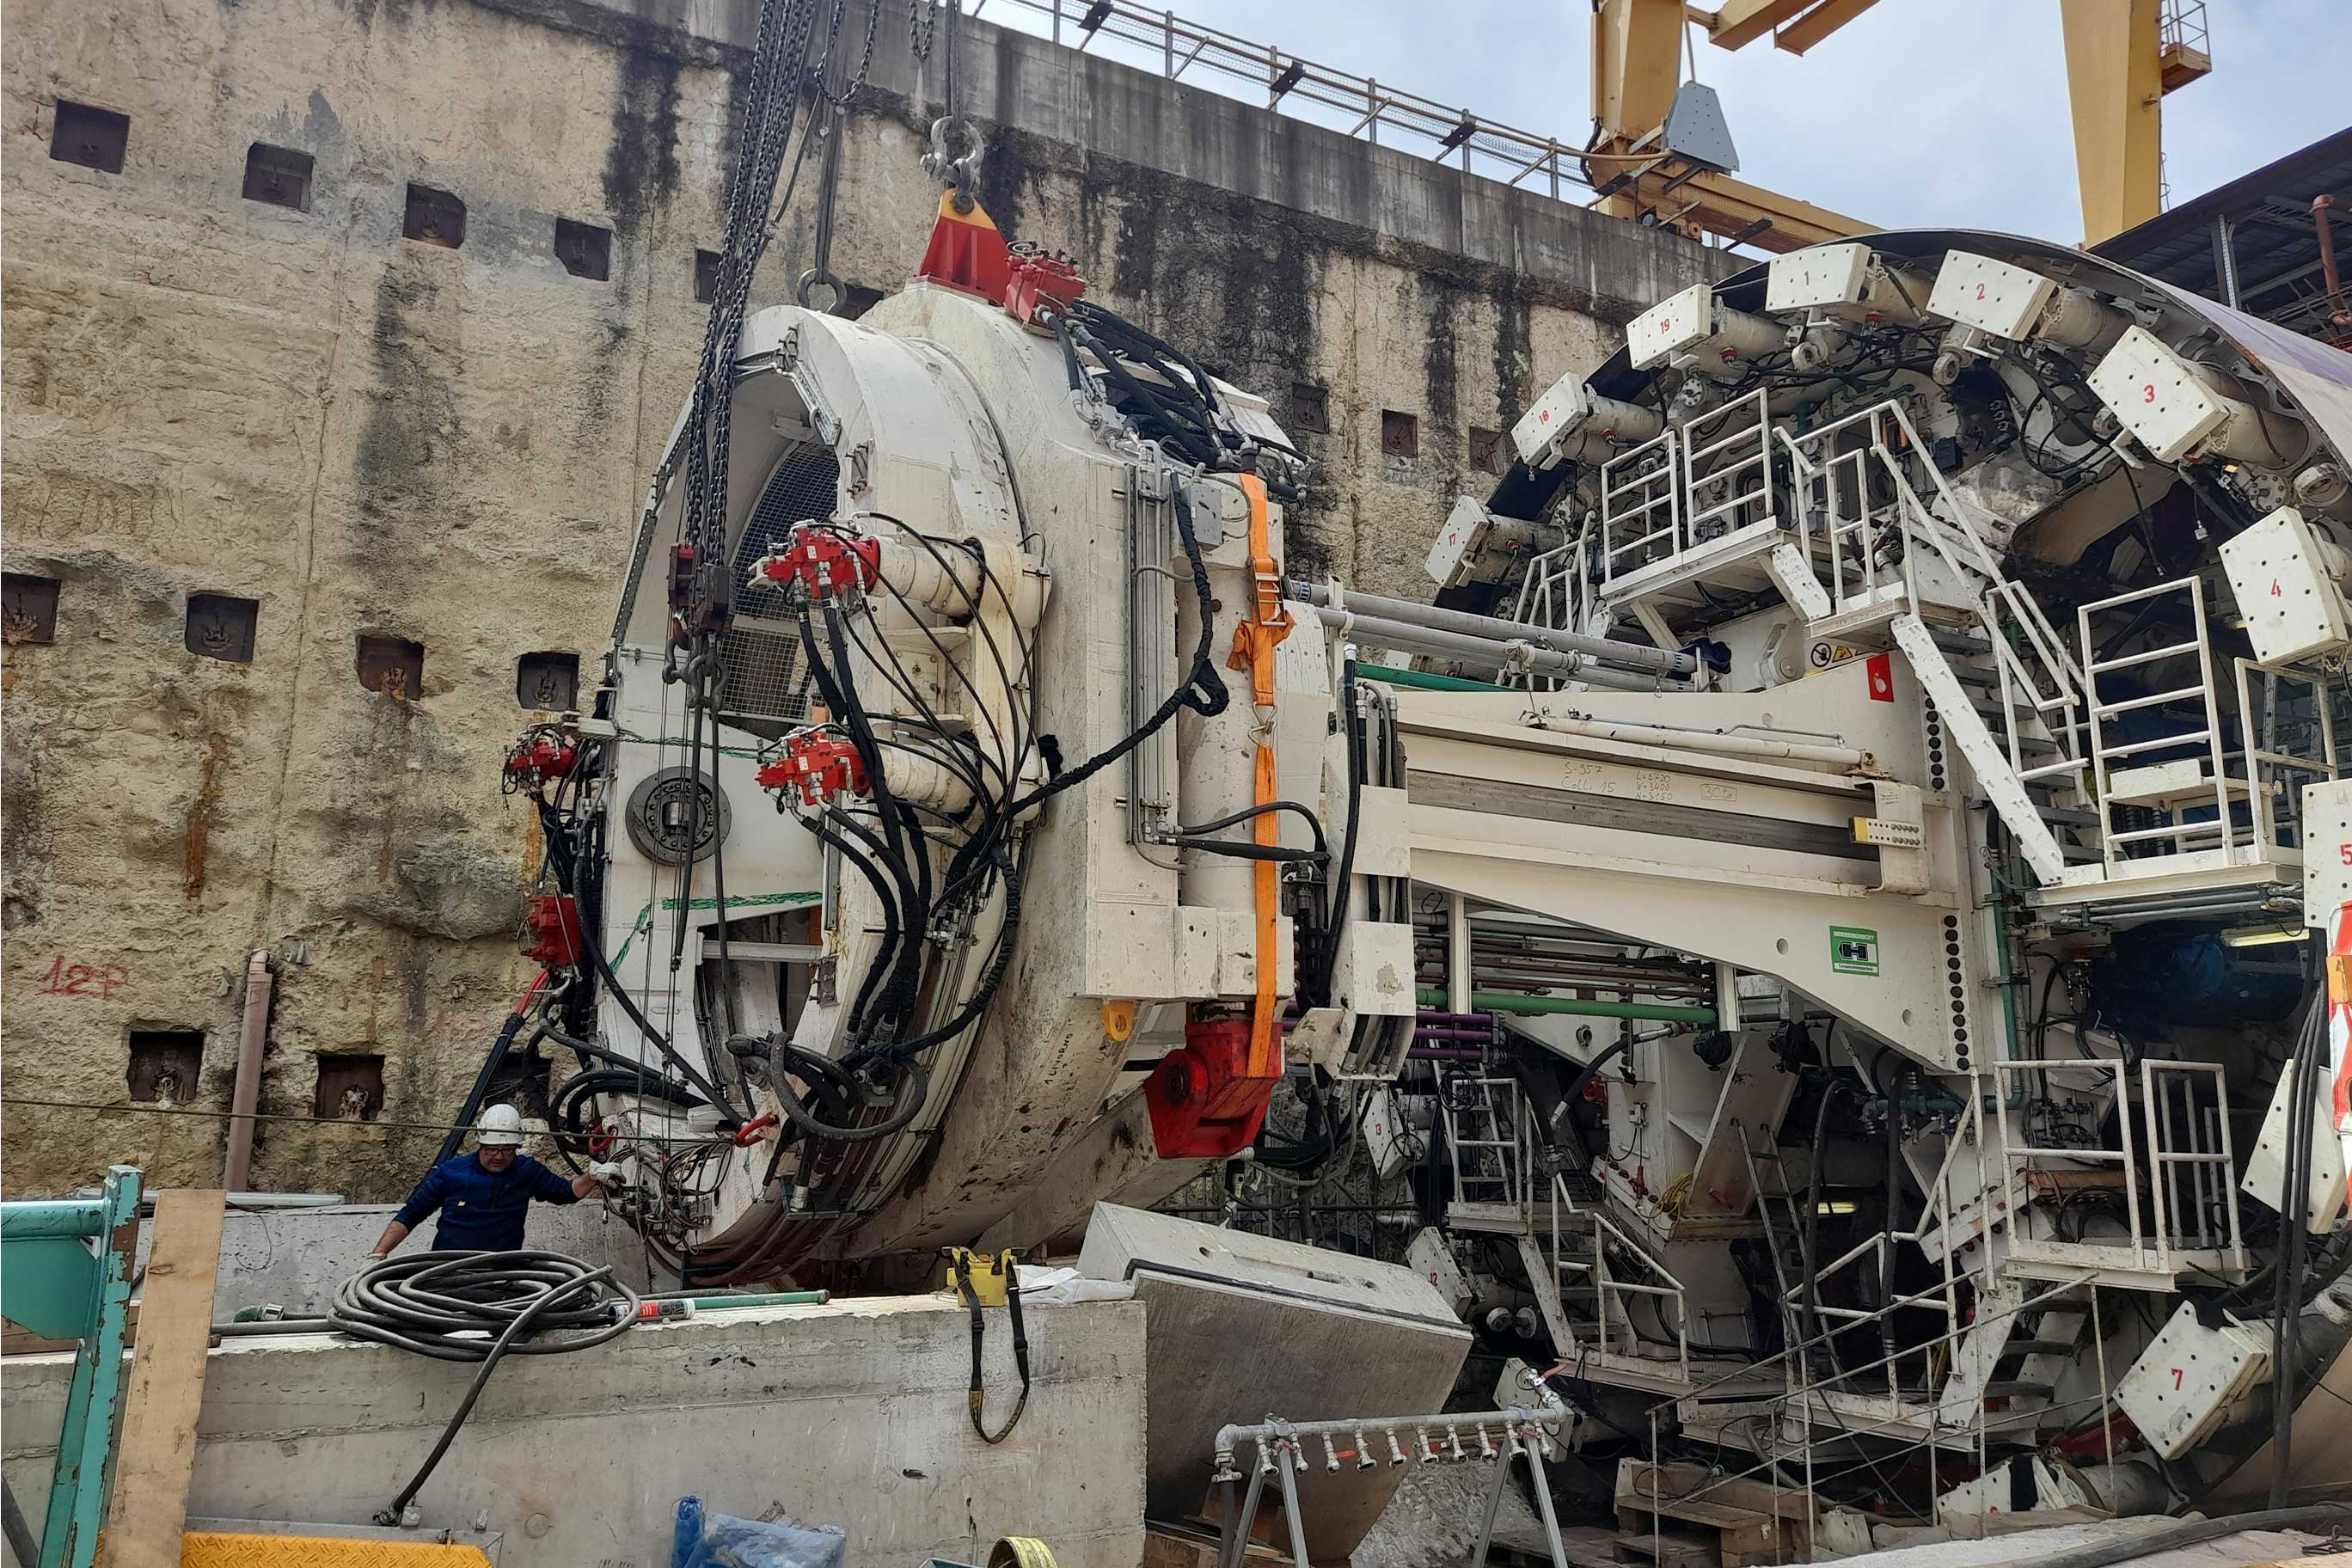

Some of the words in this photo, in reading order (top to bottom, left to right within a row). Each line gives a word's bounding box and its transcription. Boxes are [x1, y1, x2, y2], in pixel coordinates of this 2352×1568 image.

[1804, 270, 1810, 285] 1
[1975, 283, 1986, 301] 2
[1659, 318, 1670, 334] 19
[2143, 384, 2155, 403] 3
[1538, 409, 1550, 426] 18
[1449, 532, 1456, 546] 17
[2269, 579, 2282, 597] 4
[1599, 781, 1616, 793] 15
[2339, 843, 2352, 866] 5
[1375, 1123, 1381, 1136] 13
[1430, 1272, 1437, 1287] 12
[2171, 1368, 2184, 1391] 7
